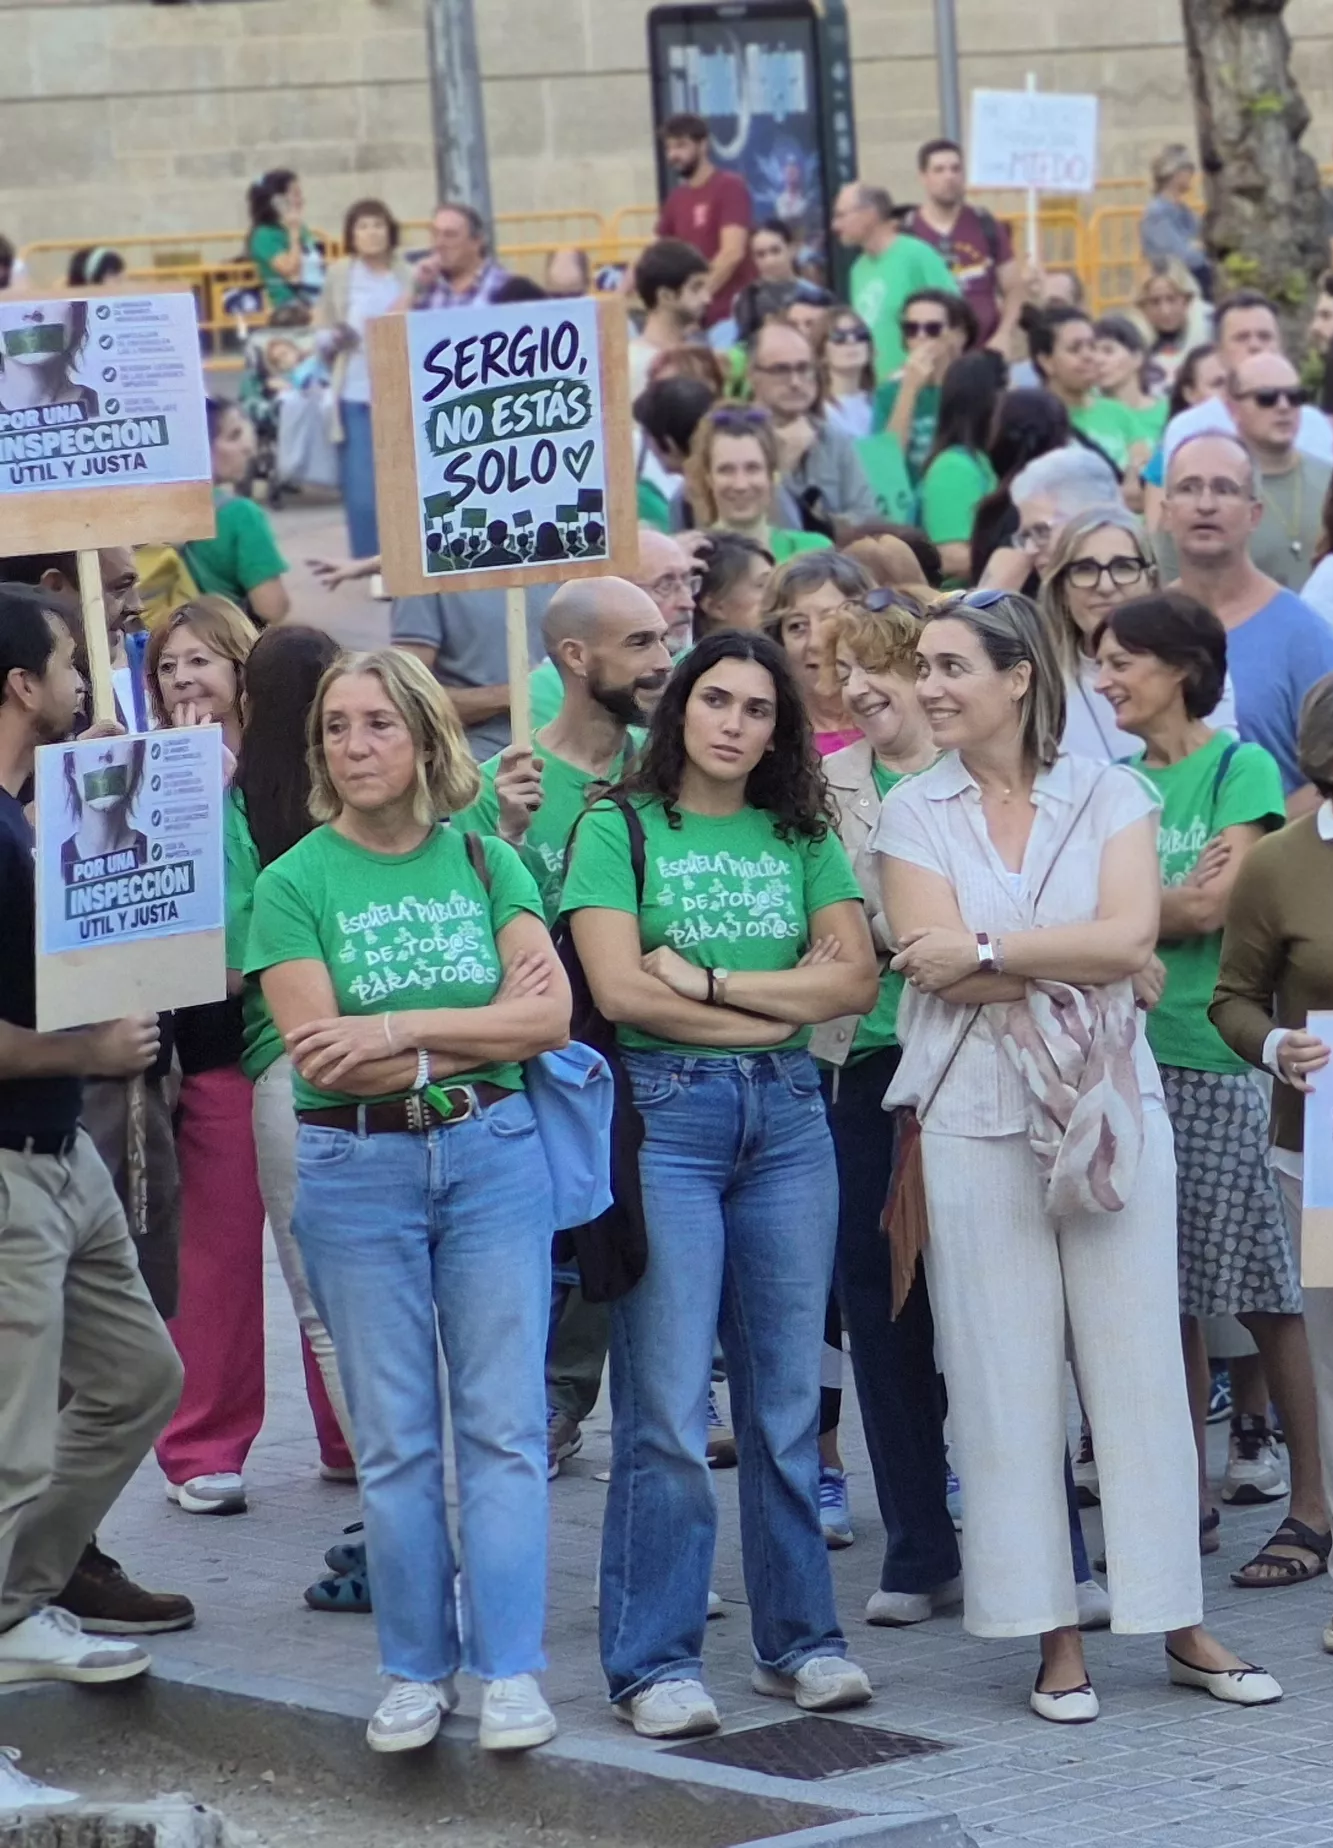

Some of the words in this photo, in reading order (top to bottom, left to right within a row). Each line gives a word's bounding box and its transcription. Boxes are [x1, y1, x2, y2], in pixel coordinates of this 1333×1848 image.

[422, 320, 588, 402] SERGIO,
[43, 404, 83, 425] UNA
[436, 404, 483, 449] NO
[492, 380, 586, 436] ESTÁS
[64, 459, 76, 478] Y
[81, 452, 148, 476] JUSTA
[443, 438, 557, 507] SOLO
[73, 860, 105, 882] POR
[107, 851, 135, 875] UNA
[658, 855, 725, 879] ESCUELA
[69, 864, 191, 916] INSPECCIÓN
[682, 896, 708, 911] DE
[118, 909, 129, 930] Y
[130, 900, 179, 929] JUSTA
[340, 902, 410, 935] ESCUELA
[365, 945, 393, 965] DE
